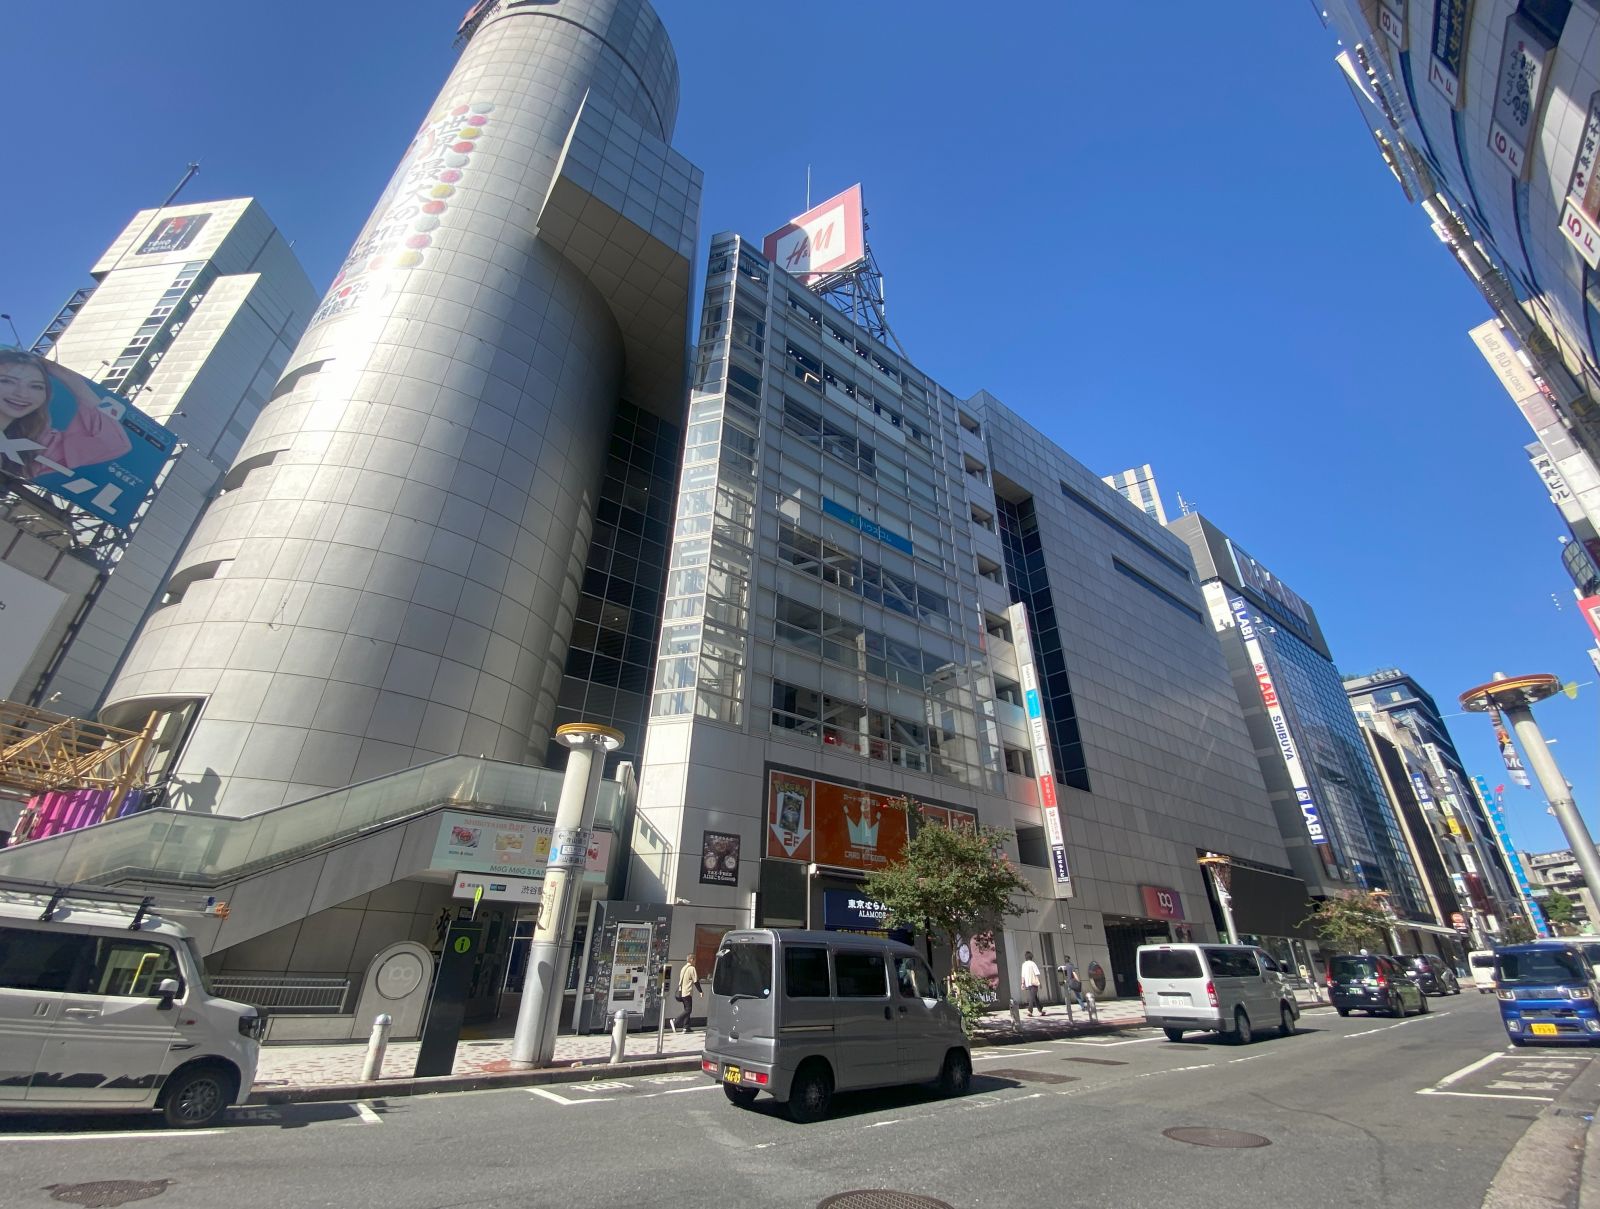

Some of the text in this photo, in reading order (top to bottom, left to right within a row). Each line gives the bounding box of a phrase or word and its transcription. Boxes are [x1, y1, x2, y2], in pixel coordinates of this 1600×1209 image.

[1495, 131, 1518, 167] 6F
[786, 221, 835, 269] H&M
[1567, 213, 1596, 254] 5F
[1235, 609, 1255, 641] LABI
[1256, 673, 1278, 709] LABI
[1272, 714, 1295, 761] SHIBUYA
[532, 825, 555, 835] SWEE
[1301, 802, 1324, 842] LABI
[783, 831, 801, 848] 2F
[527, 868, 547, 877] STAN
[1157, 891, 1174, 914] 109
[387, 965, 414, 982] 109
